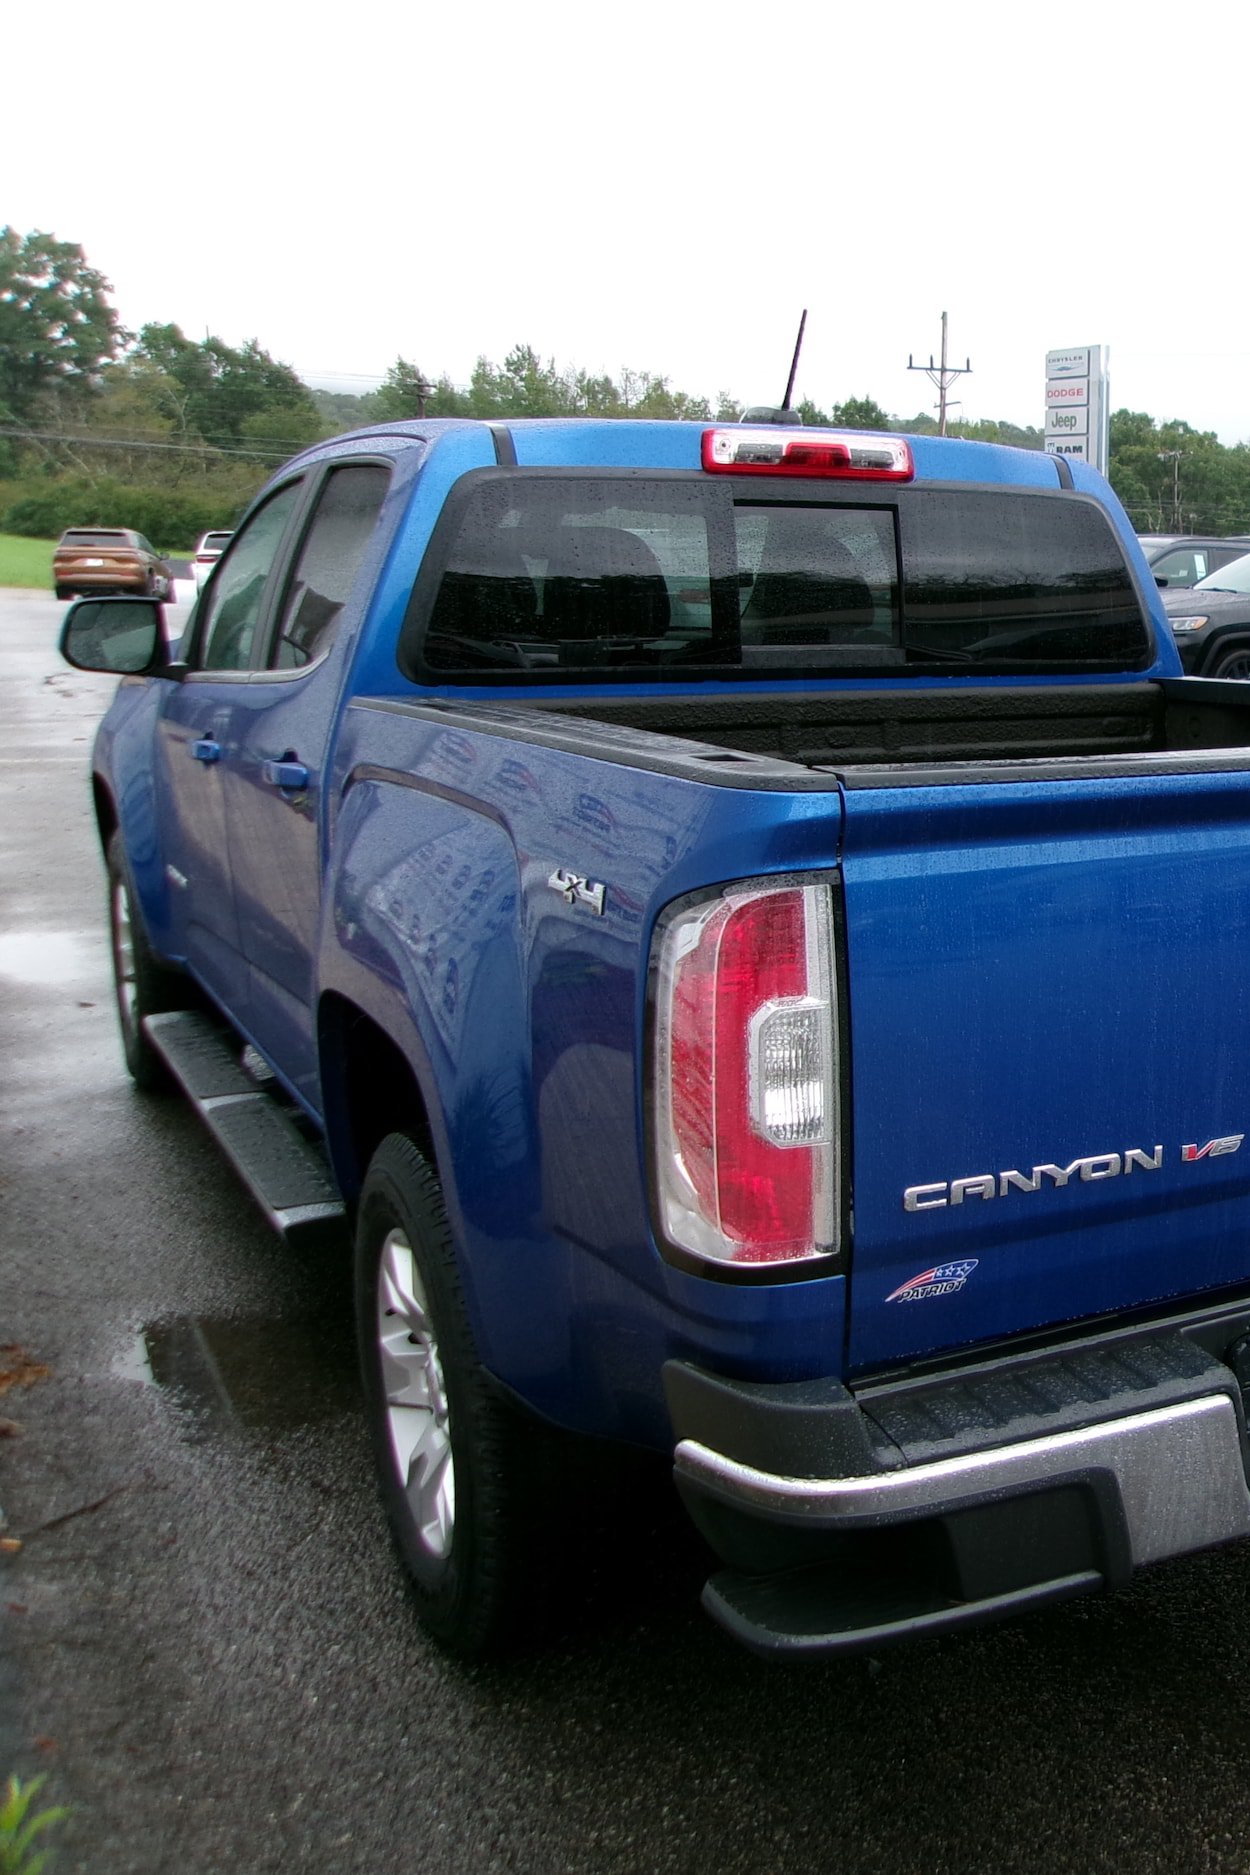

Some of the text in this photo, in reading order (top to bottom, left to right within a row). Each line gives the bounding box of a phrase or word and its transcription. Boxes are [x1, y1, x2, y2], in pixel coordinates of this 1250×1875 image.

[1048, 355, 1083, 364] CHRYSLER
[1047, 388, 1084, 398] DODGE
[1051, 411, 1078, 431] Jeep
[1056, 445, 1083, 453] RAM
[903, 1134, 1246, 1213] CANYON V6
[897, 1278, 967, 1303] PATRIOT
